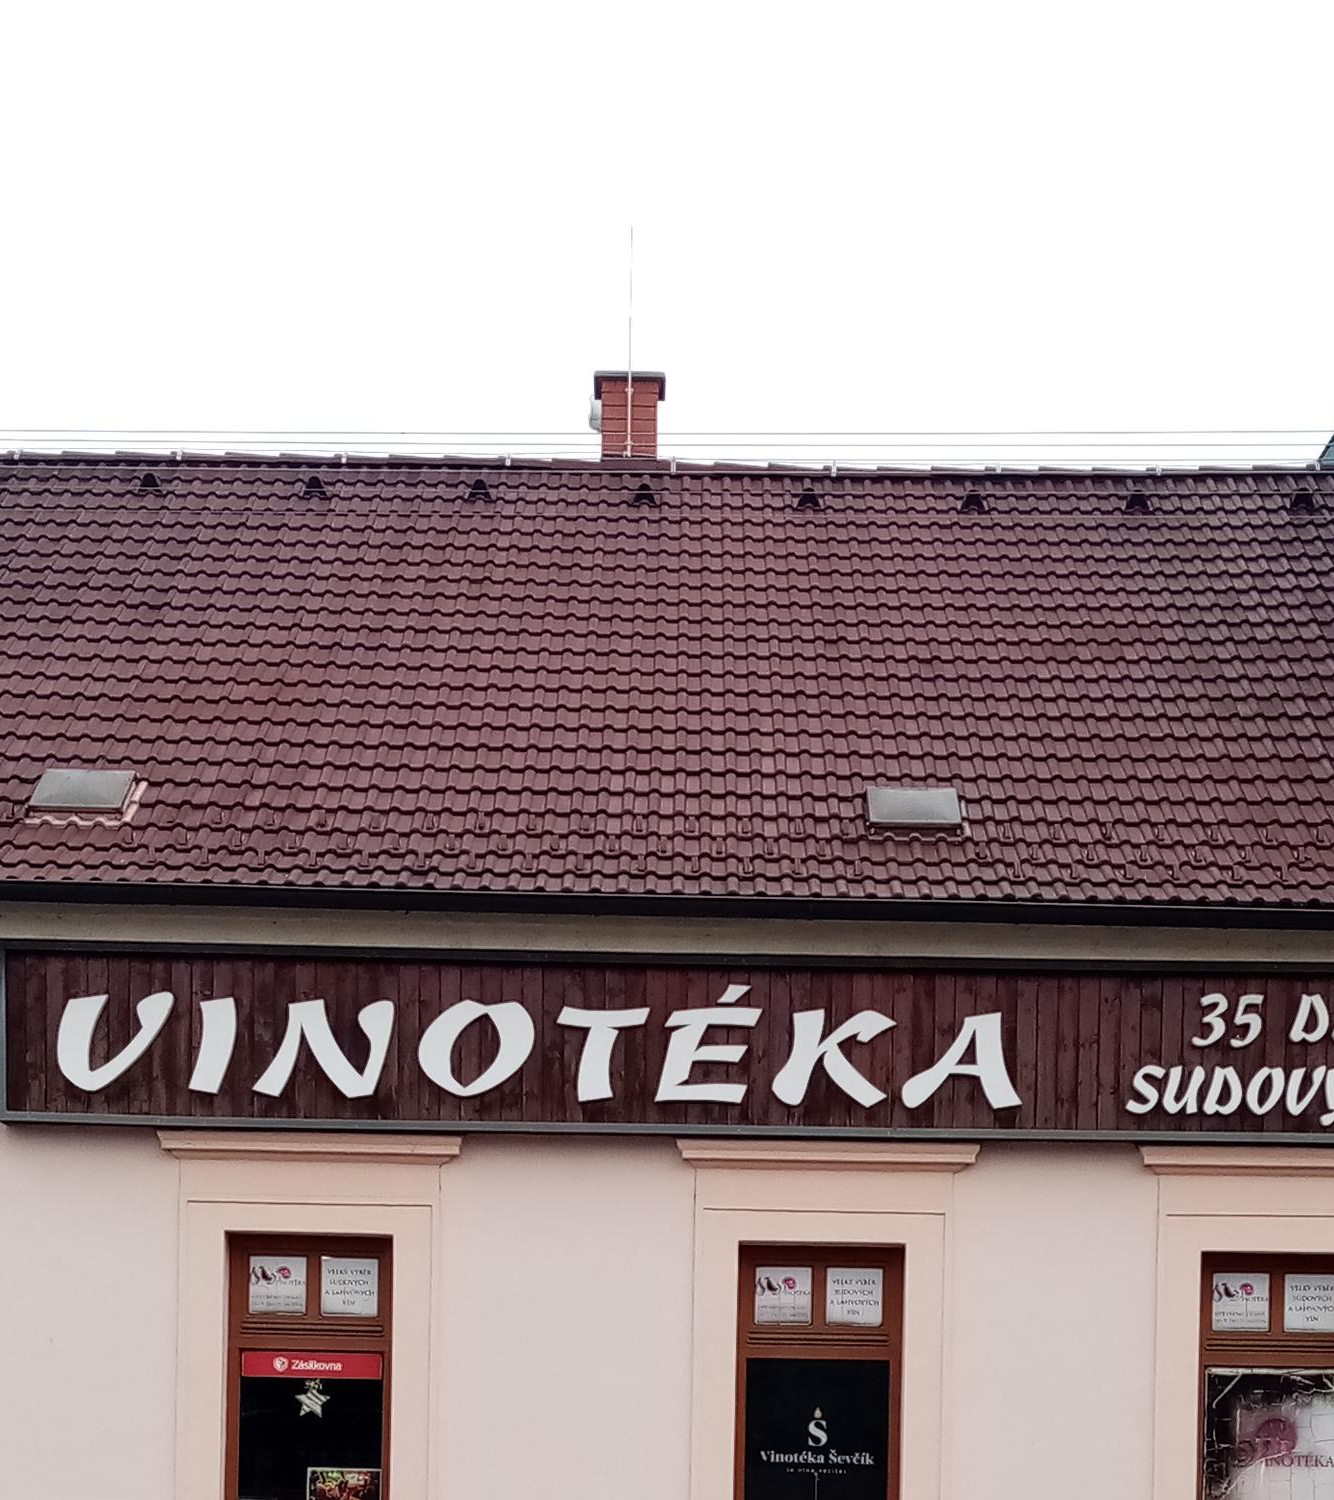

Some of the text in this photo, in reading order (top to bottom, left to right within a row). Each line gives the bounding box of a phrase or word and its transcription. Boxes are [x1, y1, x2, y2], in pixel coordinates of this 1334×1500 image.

[1190, 992, 1266, 1048] 35
[56, 983, 1024, 1110] VINOTÉKA
[290, 1359, 343, 1372] Zásilkovna
[760, 1448, 875, 1466] Vinotéka Ševčík
